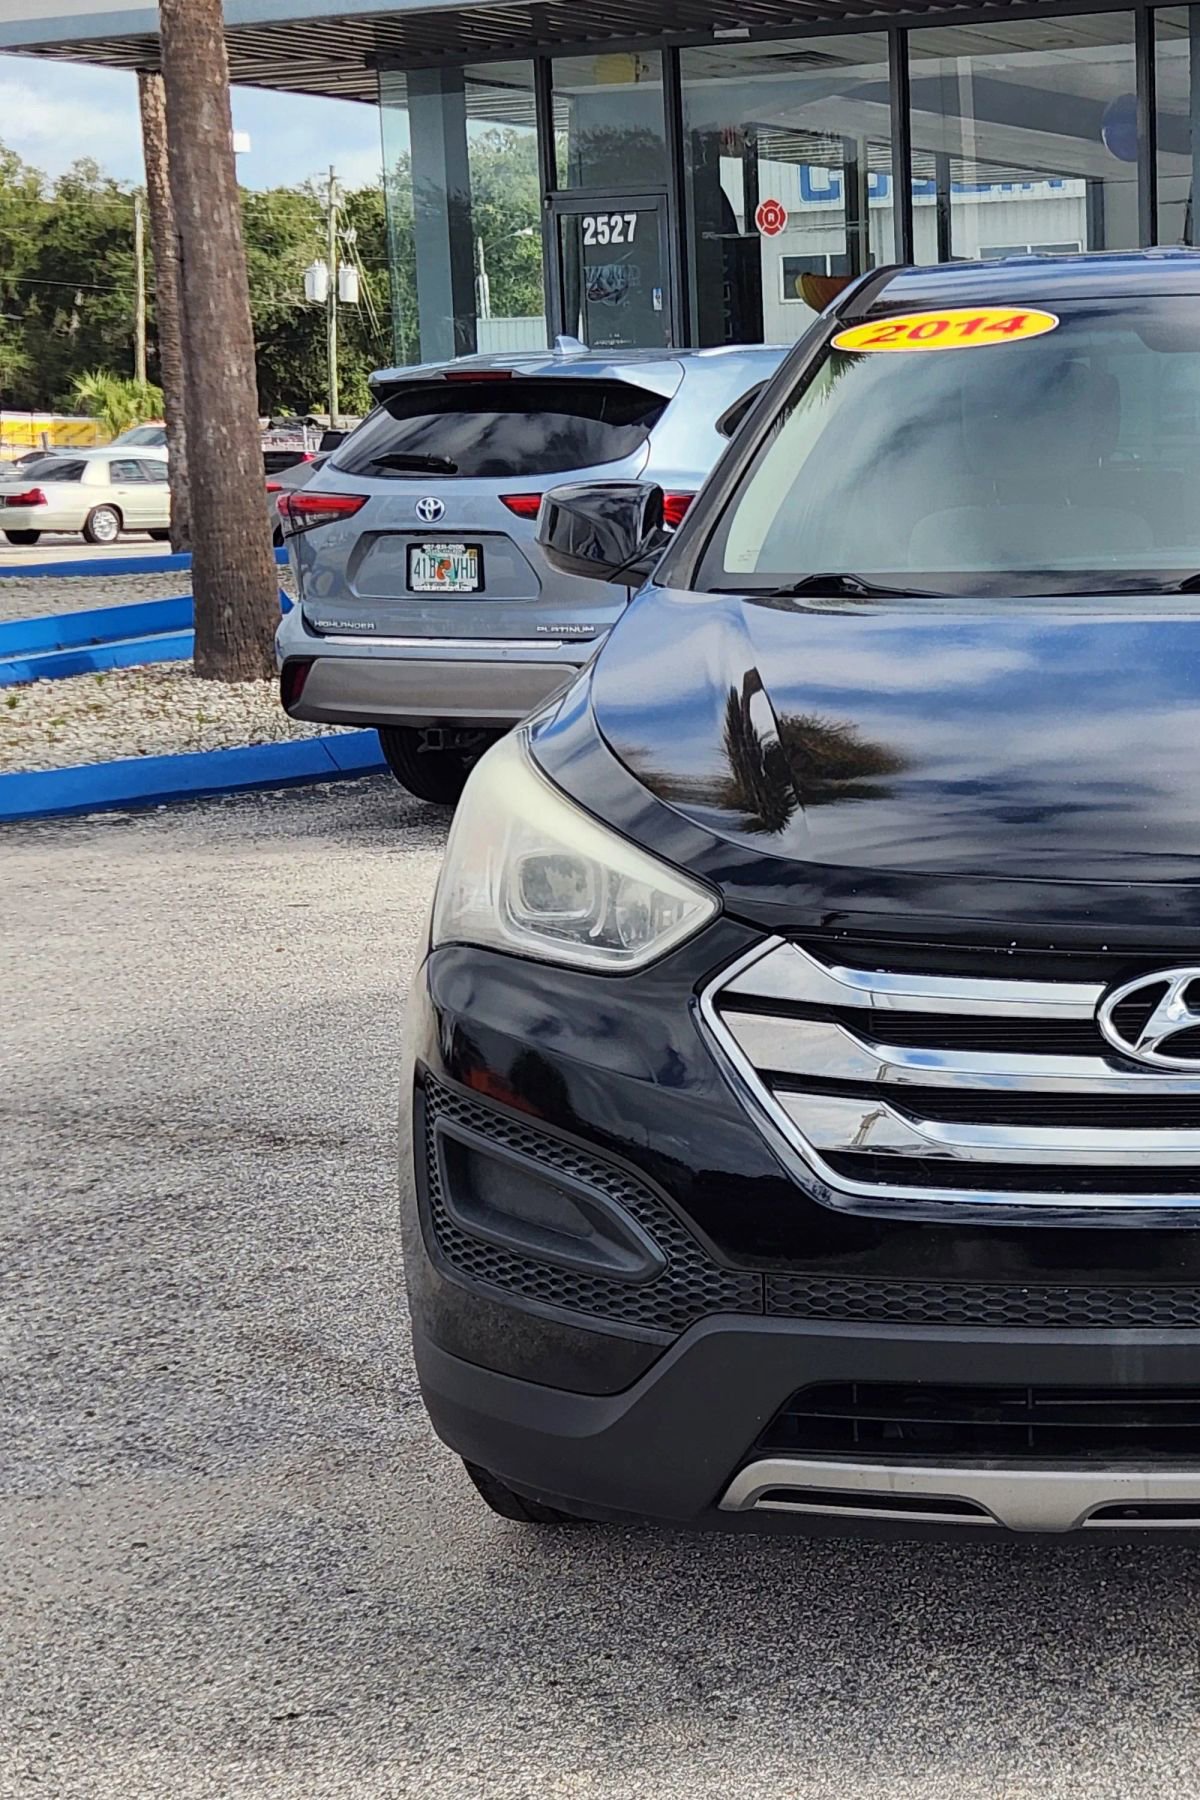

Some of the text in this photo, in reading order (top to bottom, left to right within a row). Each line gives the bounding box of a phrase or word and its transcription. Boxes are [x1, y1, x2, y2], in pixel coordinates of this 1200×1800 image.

[583, 214, 637, 245] 2527
[863, 315, 1025, 345] 2014
[536, 625, 595, 634] PLATINUM
